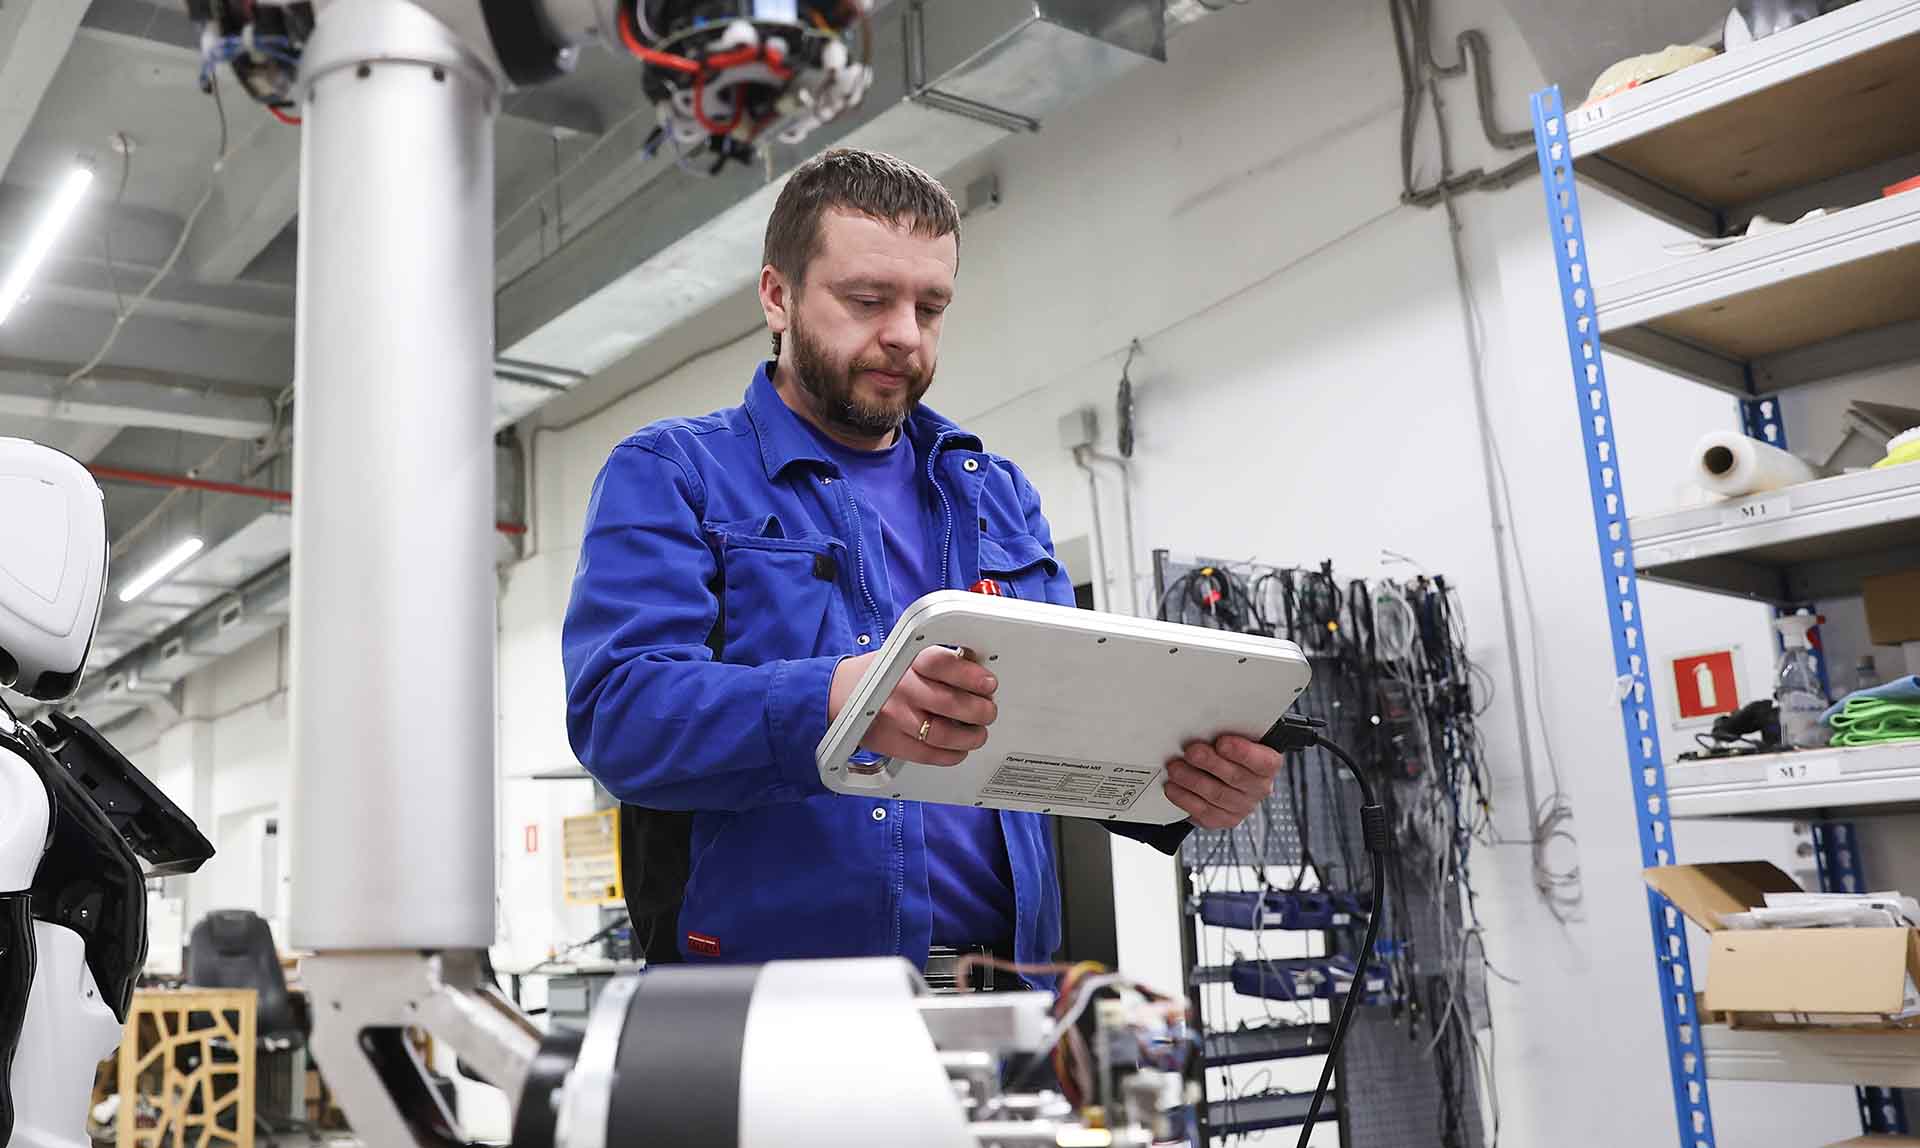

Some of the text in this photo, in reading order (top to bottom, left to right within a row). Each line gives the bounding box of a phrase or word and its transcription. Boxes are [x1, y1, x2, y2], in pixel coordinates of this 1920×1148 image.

[1741, 503, 1767, 517] M 1
[1779, 764, 1807, 778] M 7
